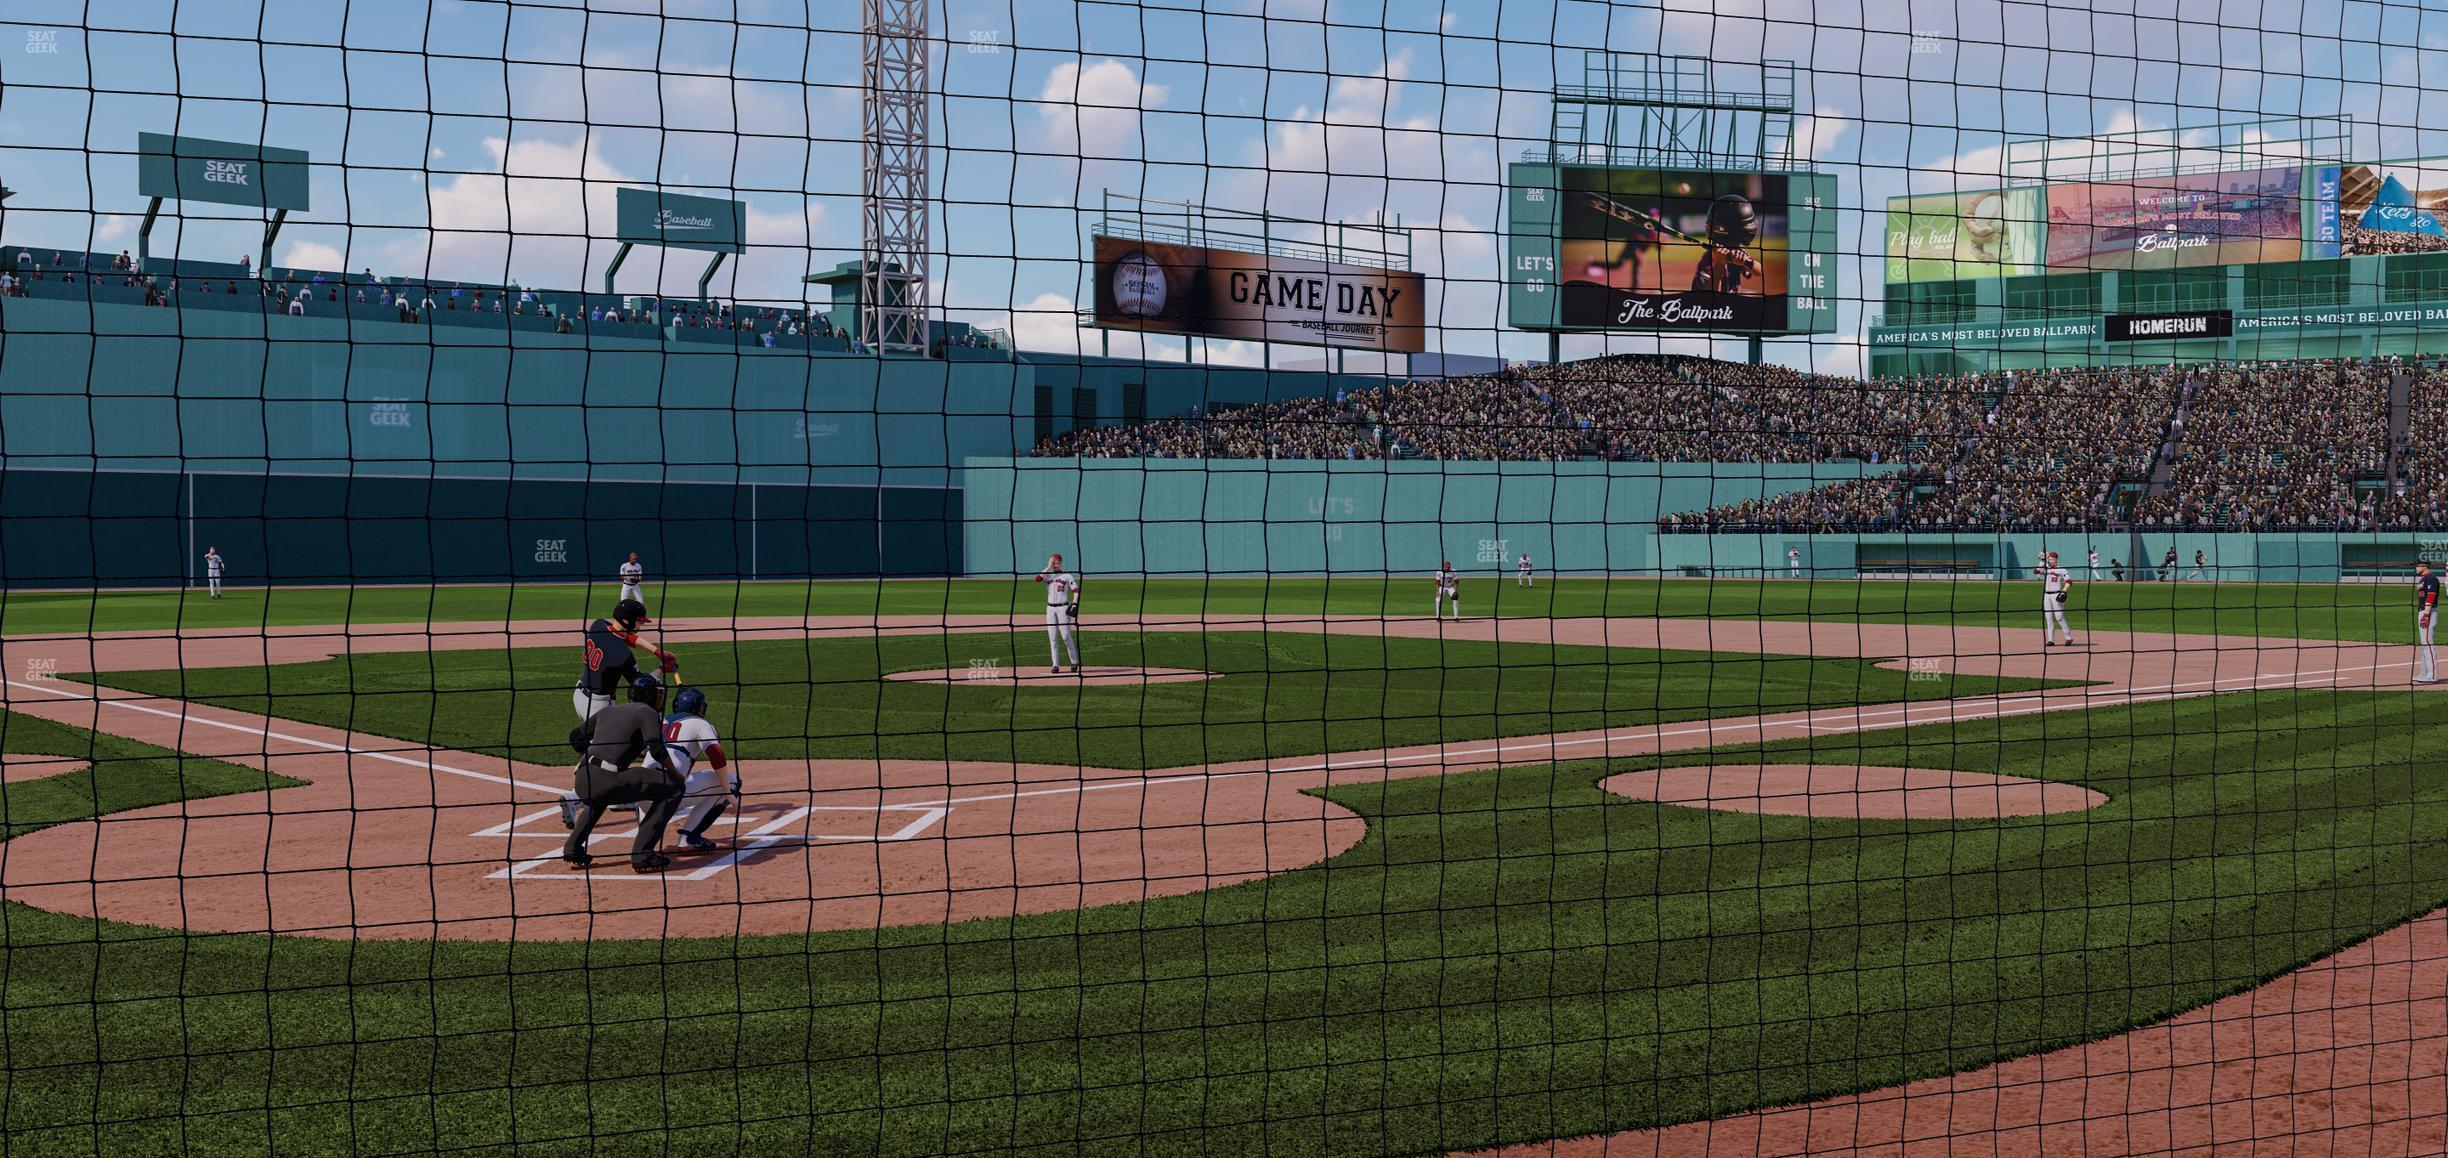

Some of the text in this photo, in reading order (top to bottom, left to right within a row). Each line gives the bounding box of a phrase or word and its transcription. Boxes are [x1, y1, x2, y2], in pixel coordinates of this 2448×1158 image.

[206, 160, 246, 174] SEAT
[203, 171, 248, 185] GEEK
[1526, 194, 1544, 202] GEEK
[2139, 194, 2205, 206] WELCOME TO
[2322, 182, 2335, 221] TEAM
[653, 209, 714, 230] Baseball
[1890, 230, 1925, 248] Play
[2136, 233, 2209, 253] Ballpark
[1517, 256, 1554, 271] LET'S
[1804, 254, 1821, 267] ON
[1527, 279, 1545, 292] GO
[1800, 275, 1824, 288] THE
[1230, 271, 1402, 319] GAME DAY
[1618, 298, 1733, 324] The Ballpark
[1797, 297, 1828, 310] BALL
[2129, 317, 2207, 334] HOMERUN
[2238, 314, 2313, 328] AMERICA'S
[2316, 313, 2355, 324] MOST
[2359, 310, 2421, 323] BELOVED
[1302, 321, 1376, 334] BASEBALL JOURNEY
[1876, 325, 2097, 343] AMERICA'S MOST BELOVED BALLPARK
[371, 412, 411, 427] GEEK
[583, 639, 603, 671] 00
